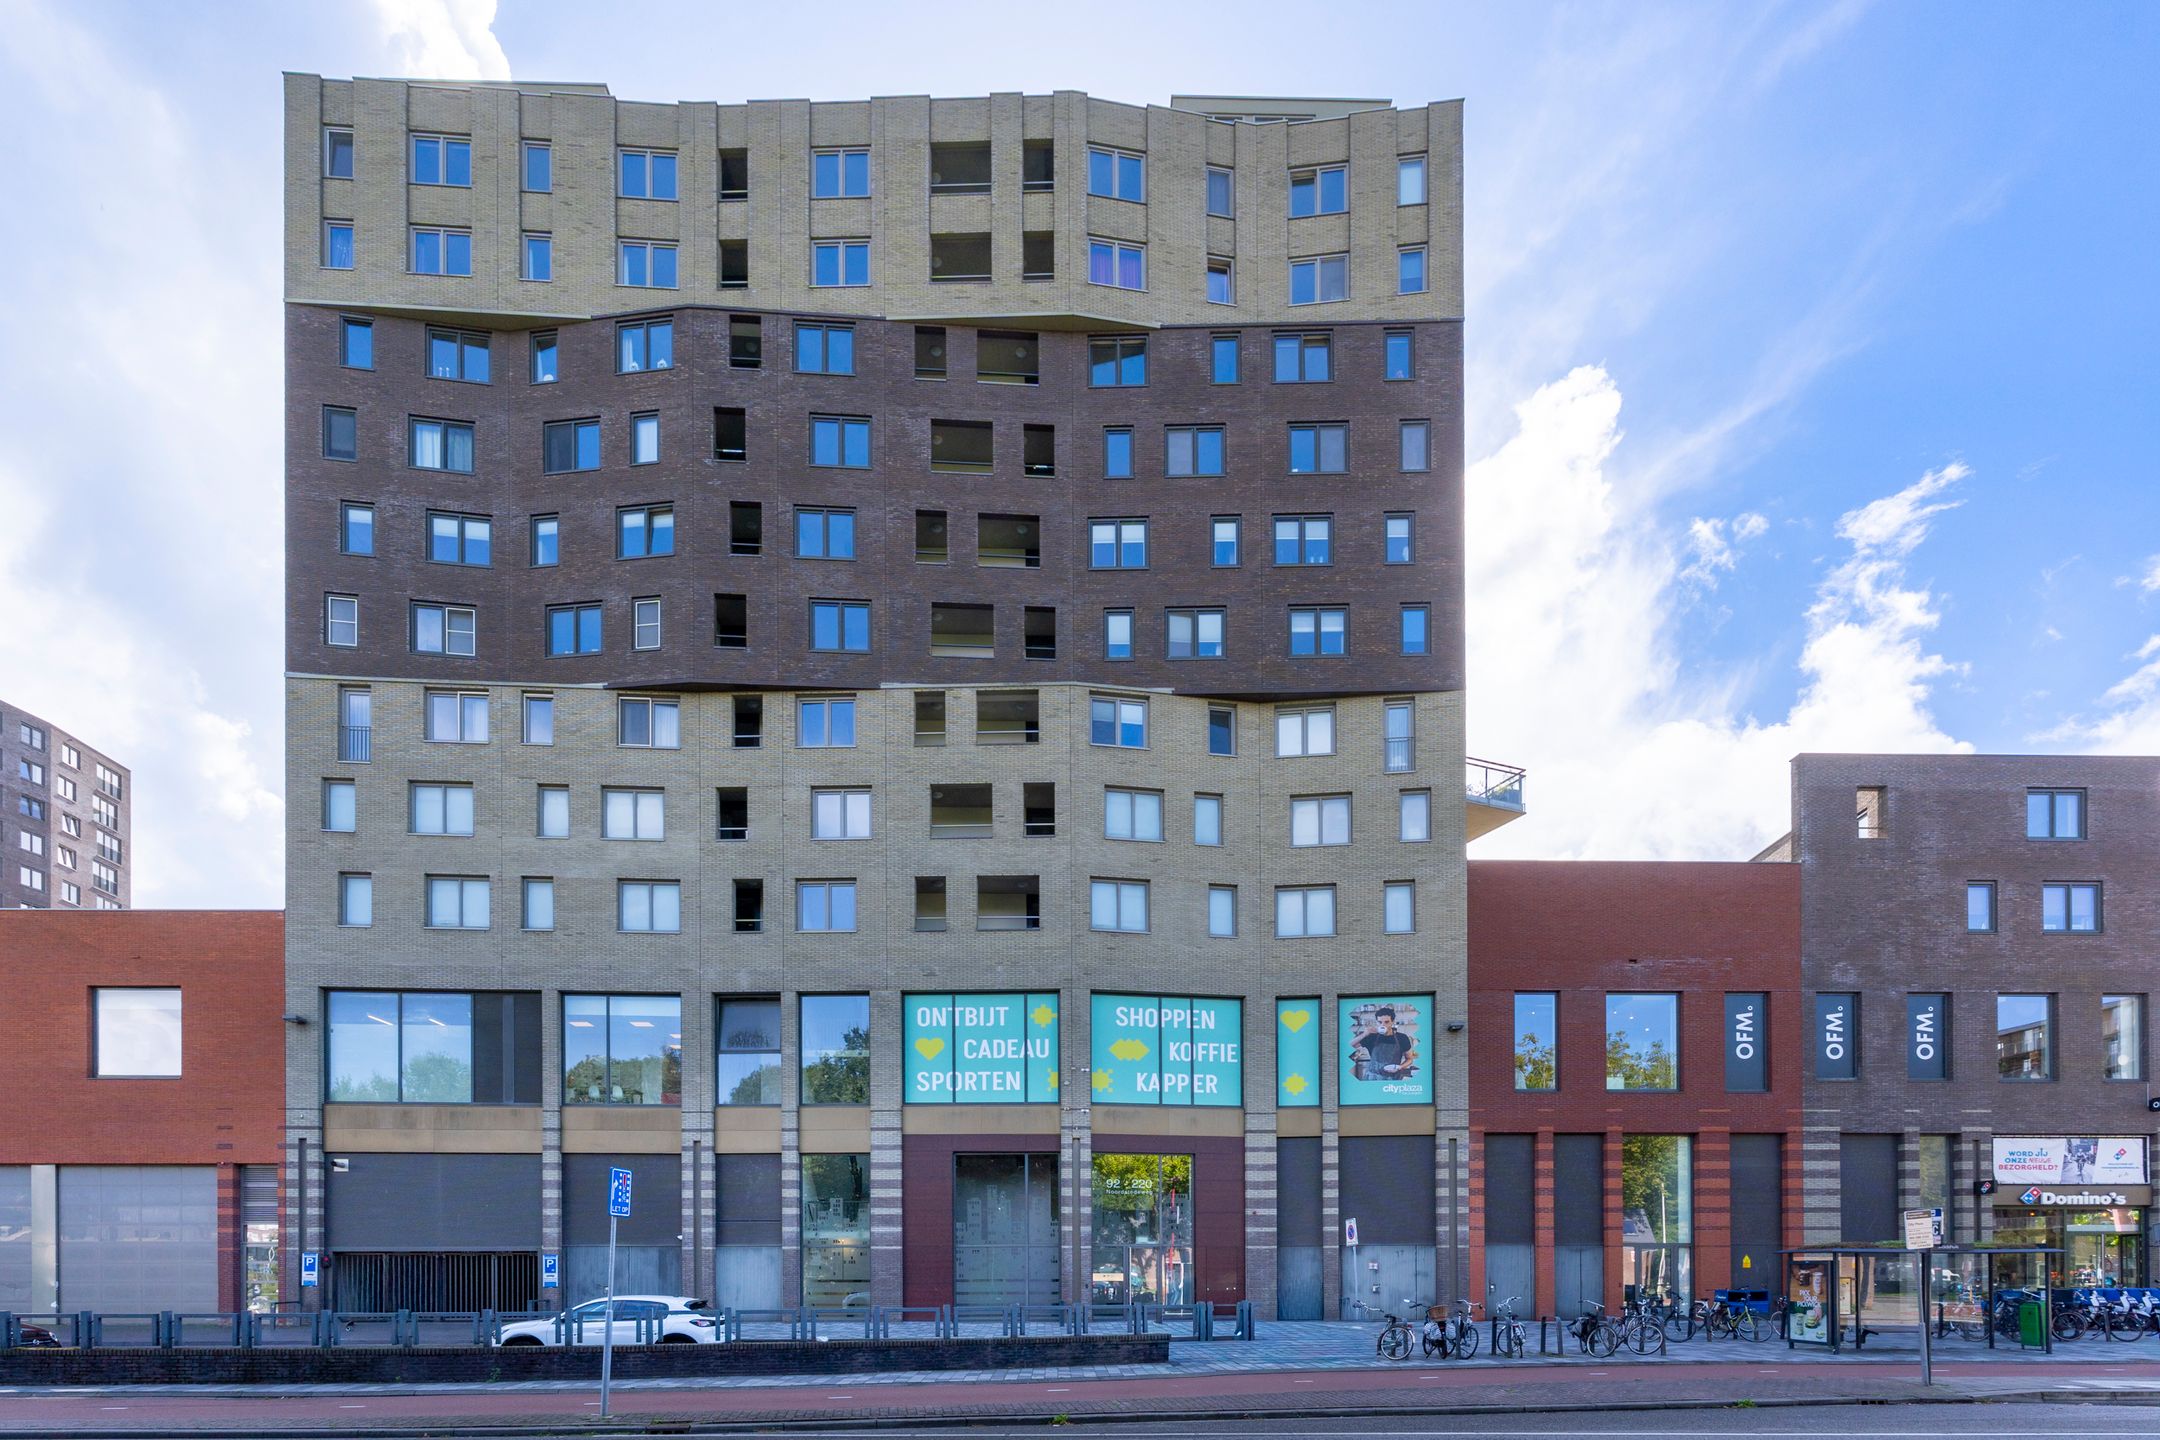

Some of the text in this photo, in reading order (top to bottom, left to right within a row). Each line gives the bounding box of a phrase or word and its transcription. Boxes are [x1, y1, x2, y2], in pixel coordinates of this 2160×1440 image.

[916, 1006, 1009, 1027] ONTBIJT
[1115, 1006, 1215, 1030] SHOPPEN
[963, 1038, 1050, 1059] CADEAU
[1169, 1041, 1238, 1064] KOFFIE
[916, 1070, 1021, 1092] SPORTEN
[1136, 1072, 1218, 1094] KAPPER
[1106, 1179, 1120, 1188] 92
[1131, 1179, 1153, 1188] 220
[2040, 1191, 2127, 1205] Domino's
[306, 1257, 314, 1267] P
[546, 1259, 554, 1268] P
